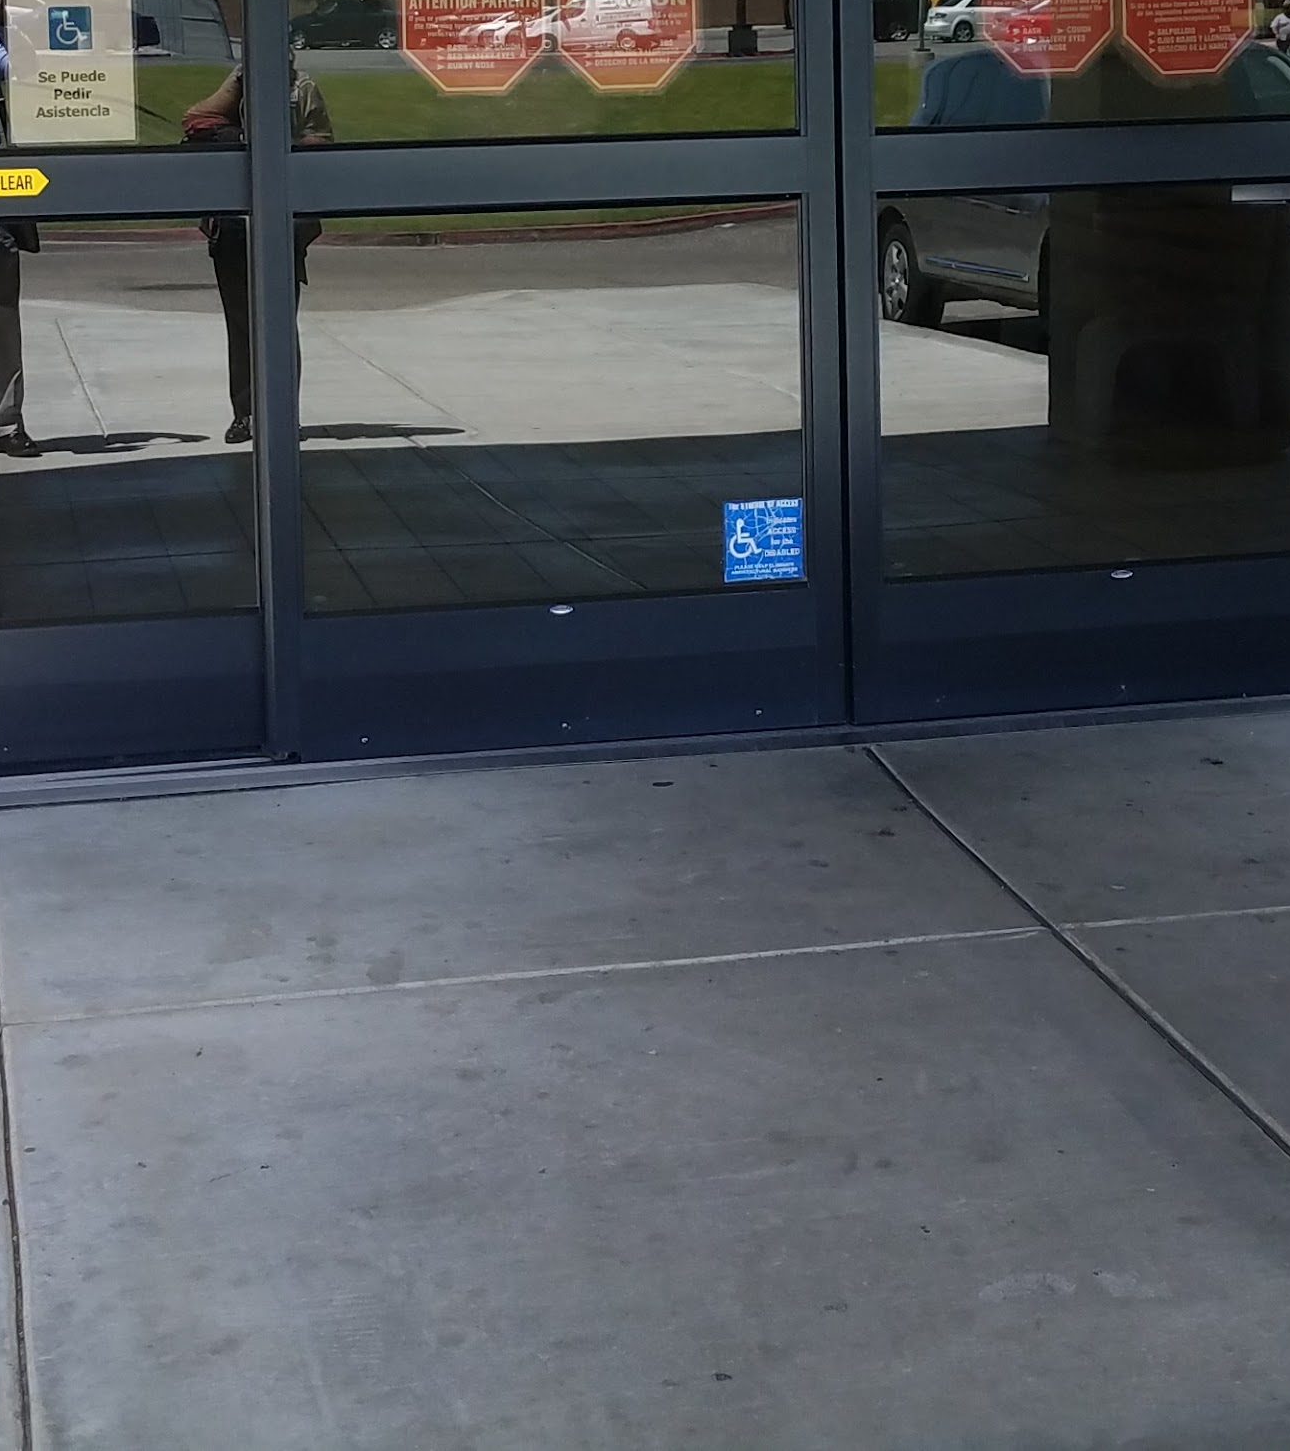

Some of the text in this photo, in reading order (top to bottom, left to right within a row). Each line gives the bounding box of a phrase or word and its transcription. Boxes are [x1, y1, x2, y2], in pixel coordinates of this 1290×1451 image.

[38, 70, 106, 83] Se Puede
[53, 88, 92, 100] Pedir
[35, 105, 110, 118] Asistencia
